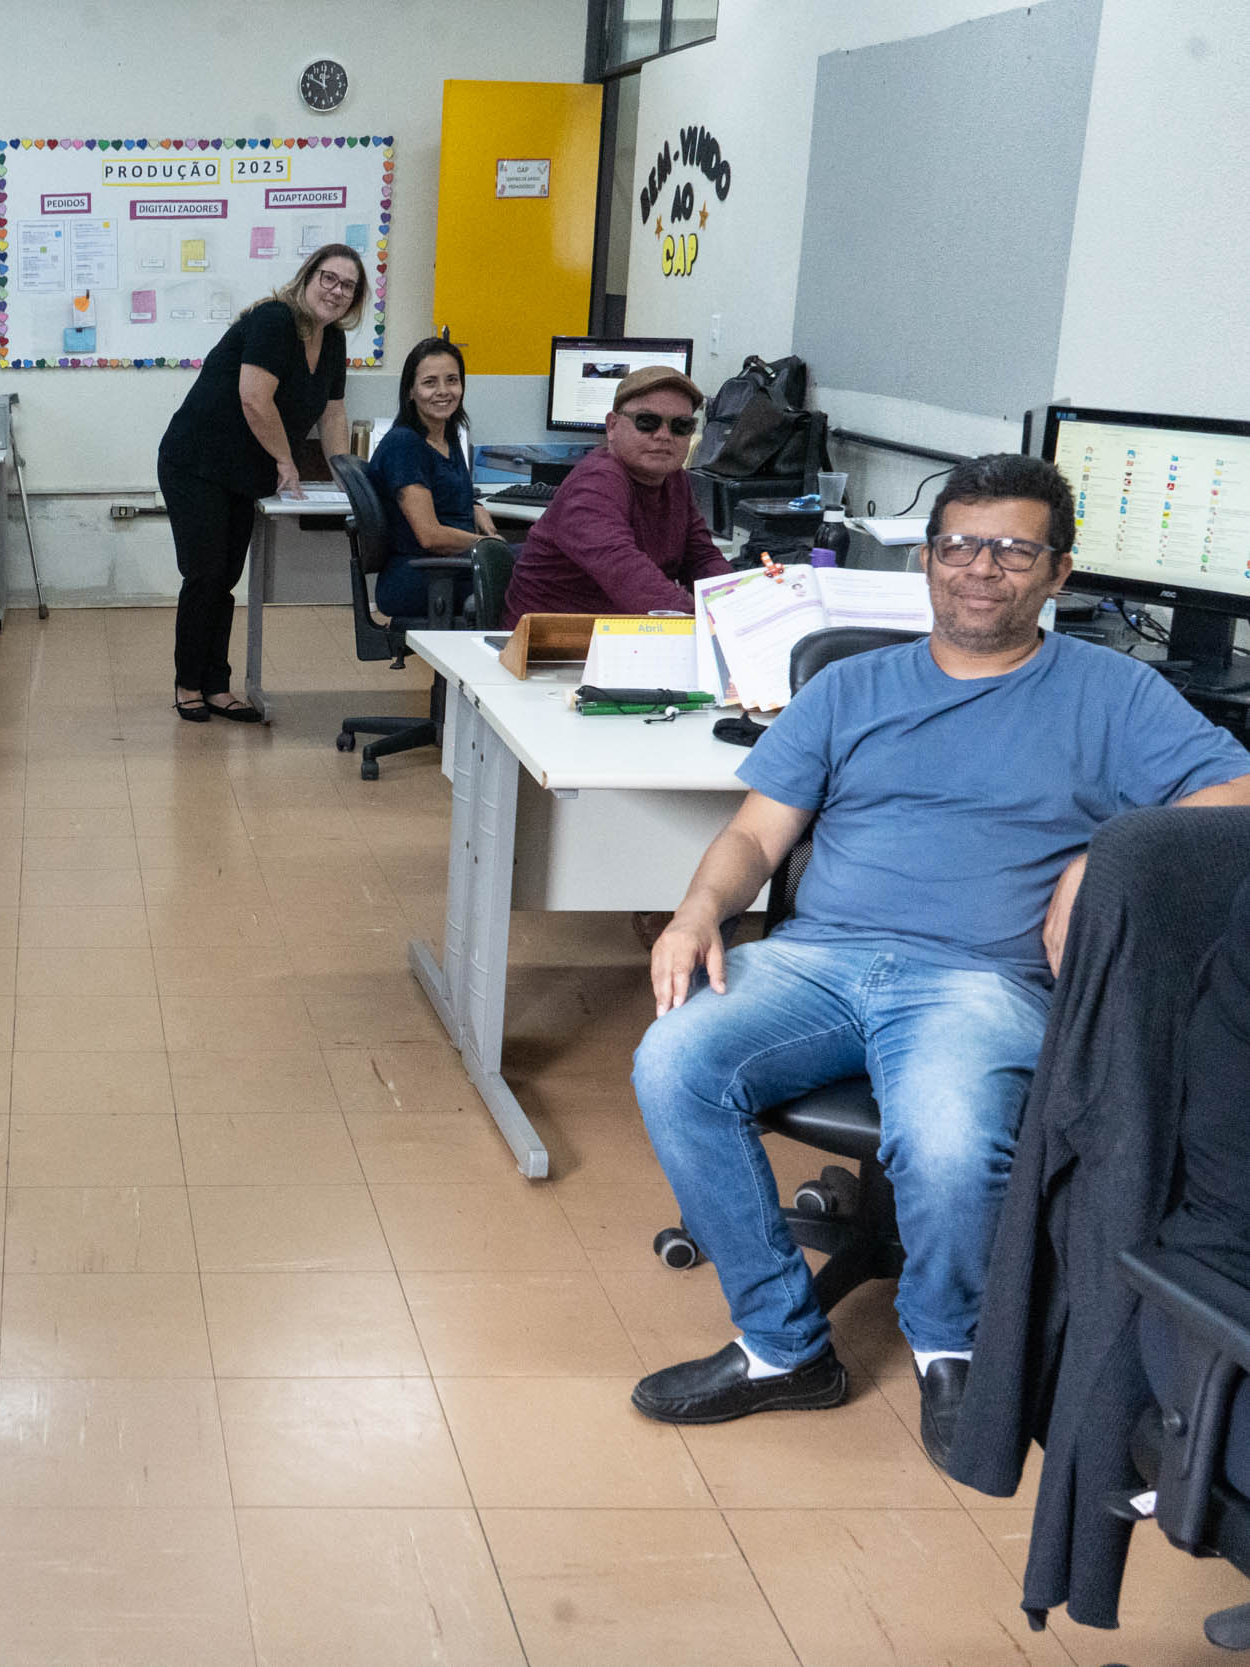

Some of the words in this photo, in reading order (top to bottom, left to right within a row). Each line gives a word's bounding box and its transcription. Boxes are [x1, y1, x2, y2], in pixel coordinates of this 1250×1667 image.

[105, 161, 216, 181] PRODUÇÃO
[237, 160, 284, 175] 2025
[46, 198, 86, 209] PEDIDOS
[272, 192, 338, 203] ADAPTADORES
[670, 182, 694, 224] AO
[661, 232, 699, 277] CAP
[637, 623, 663, 633] Abril
